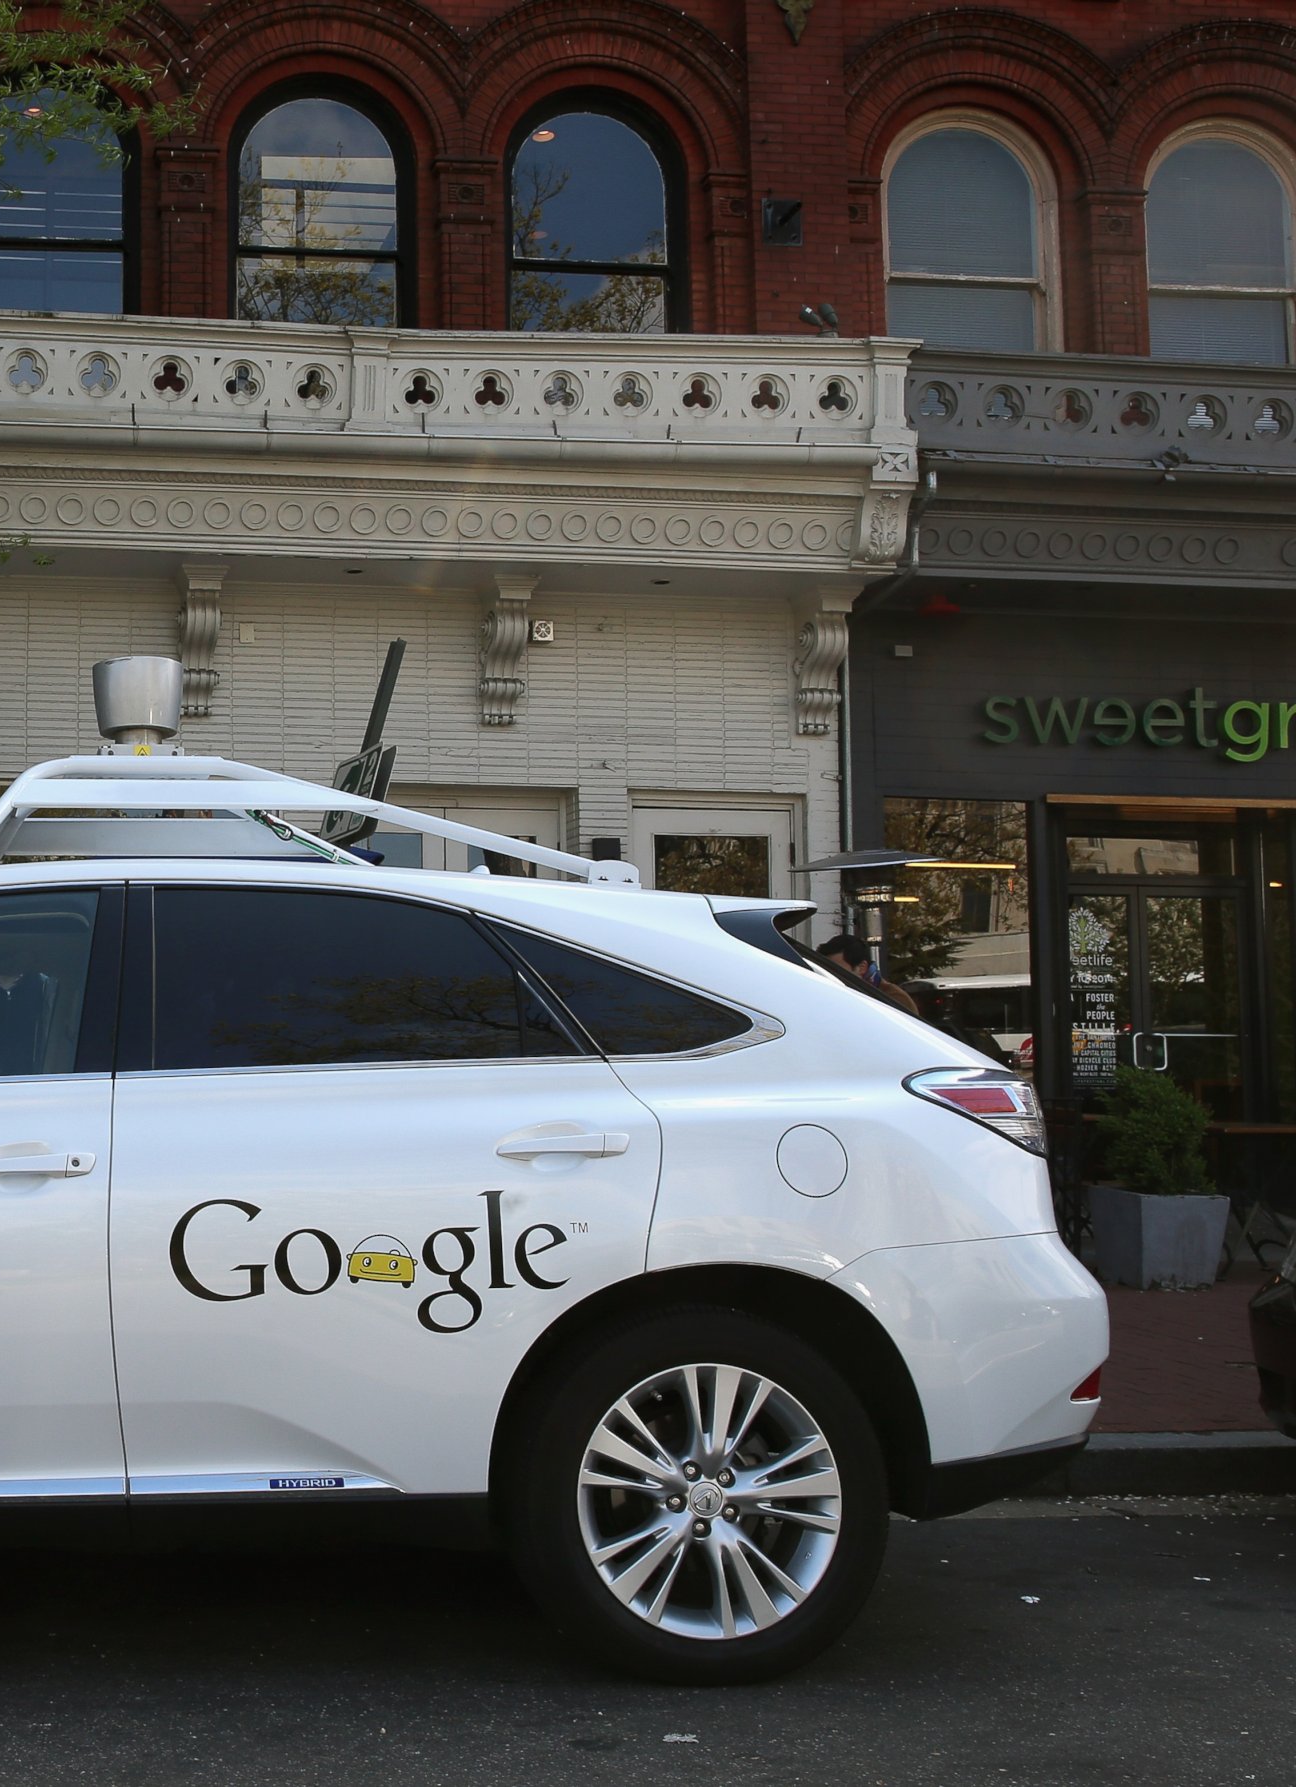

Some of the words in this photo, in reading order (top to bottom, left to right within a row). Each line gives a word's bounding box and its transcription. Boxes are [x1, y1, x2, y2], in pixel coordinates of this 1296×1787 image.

[1085, 993, 1115, 1002] FOSTER
[1086, 1011, 1115, 1020] PEOPLE
[278, 1478, 336, 1488] HYBRID
